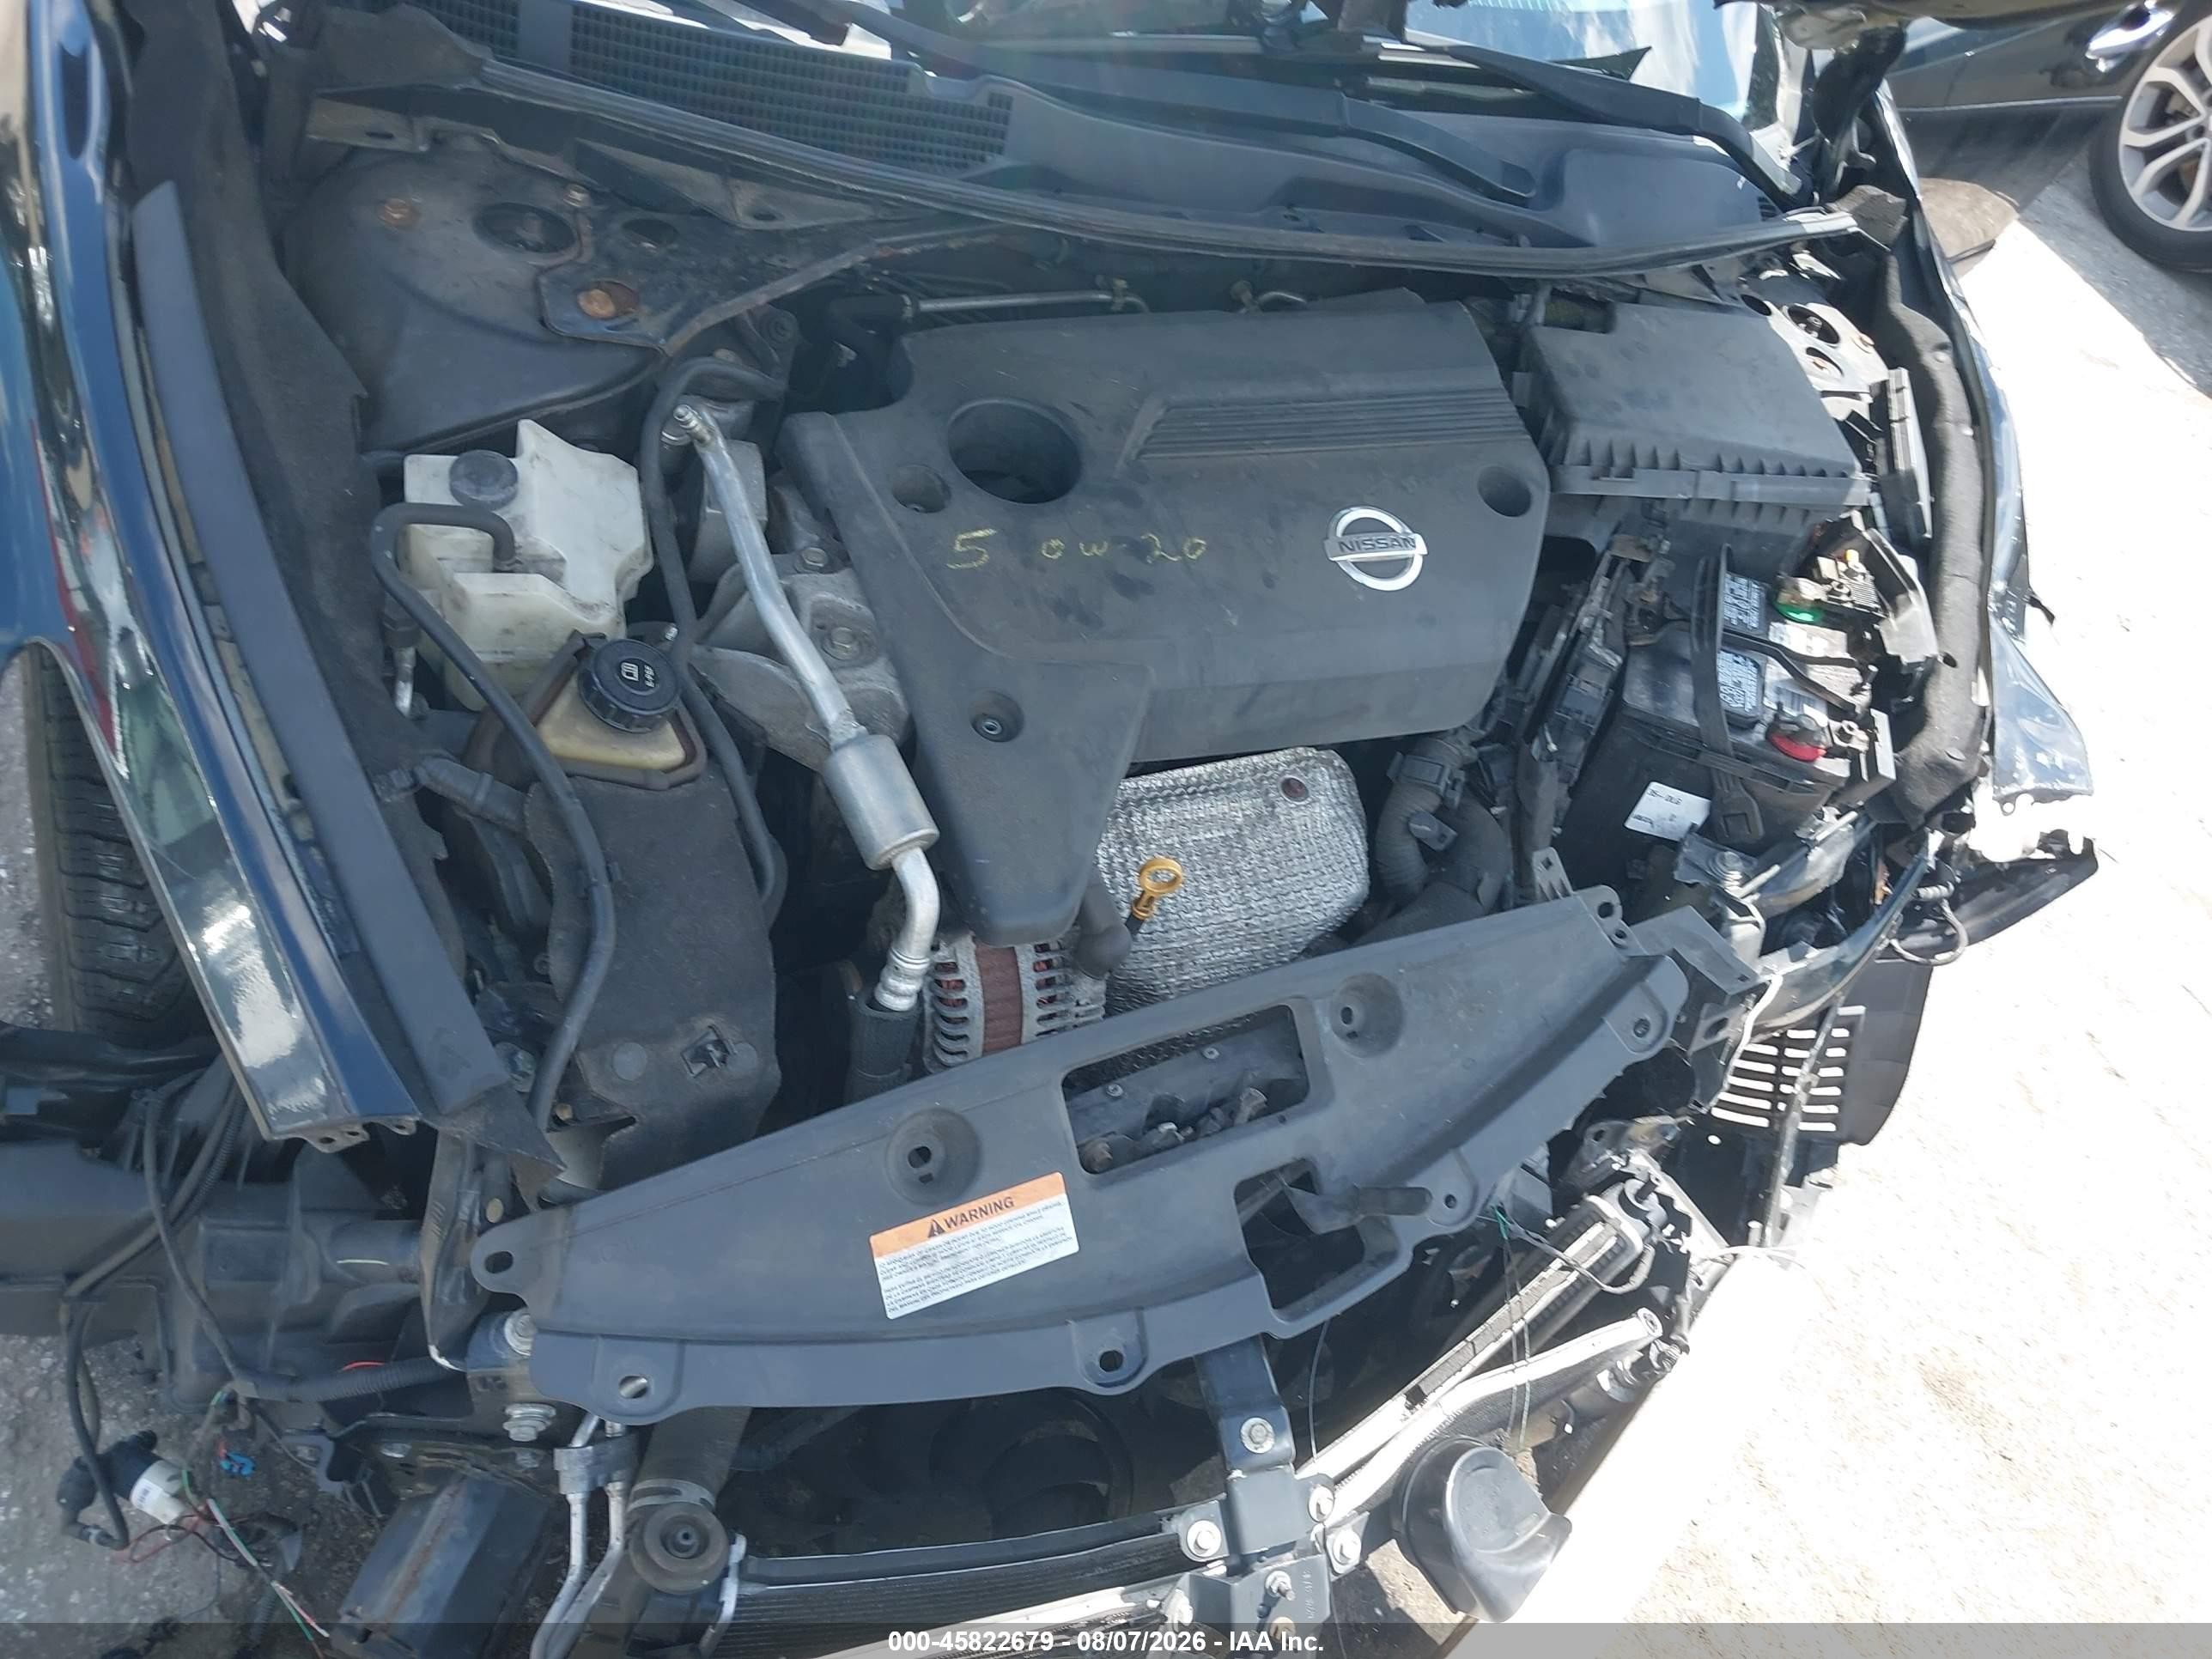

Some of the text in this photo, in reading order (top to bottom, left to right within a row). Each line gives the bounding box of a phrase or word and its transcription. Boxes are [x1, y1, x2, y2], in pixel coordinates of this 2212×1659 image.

[945, 528, 999, 569] 5
[1339, 535, 1417, 552] NISSAN
[945, 1196, 1015, 1229] WARNING
